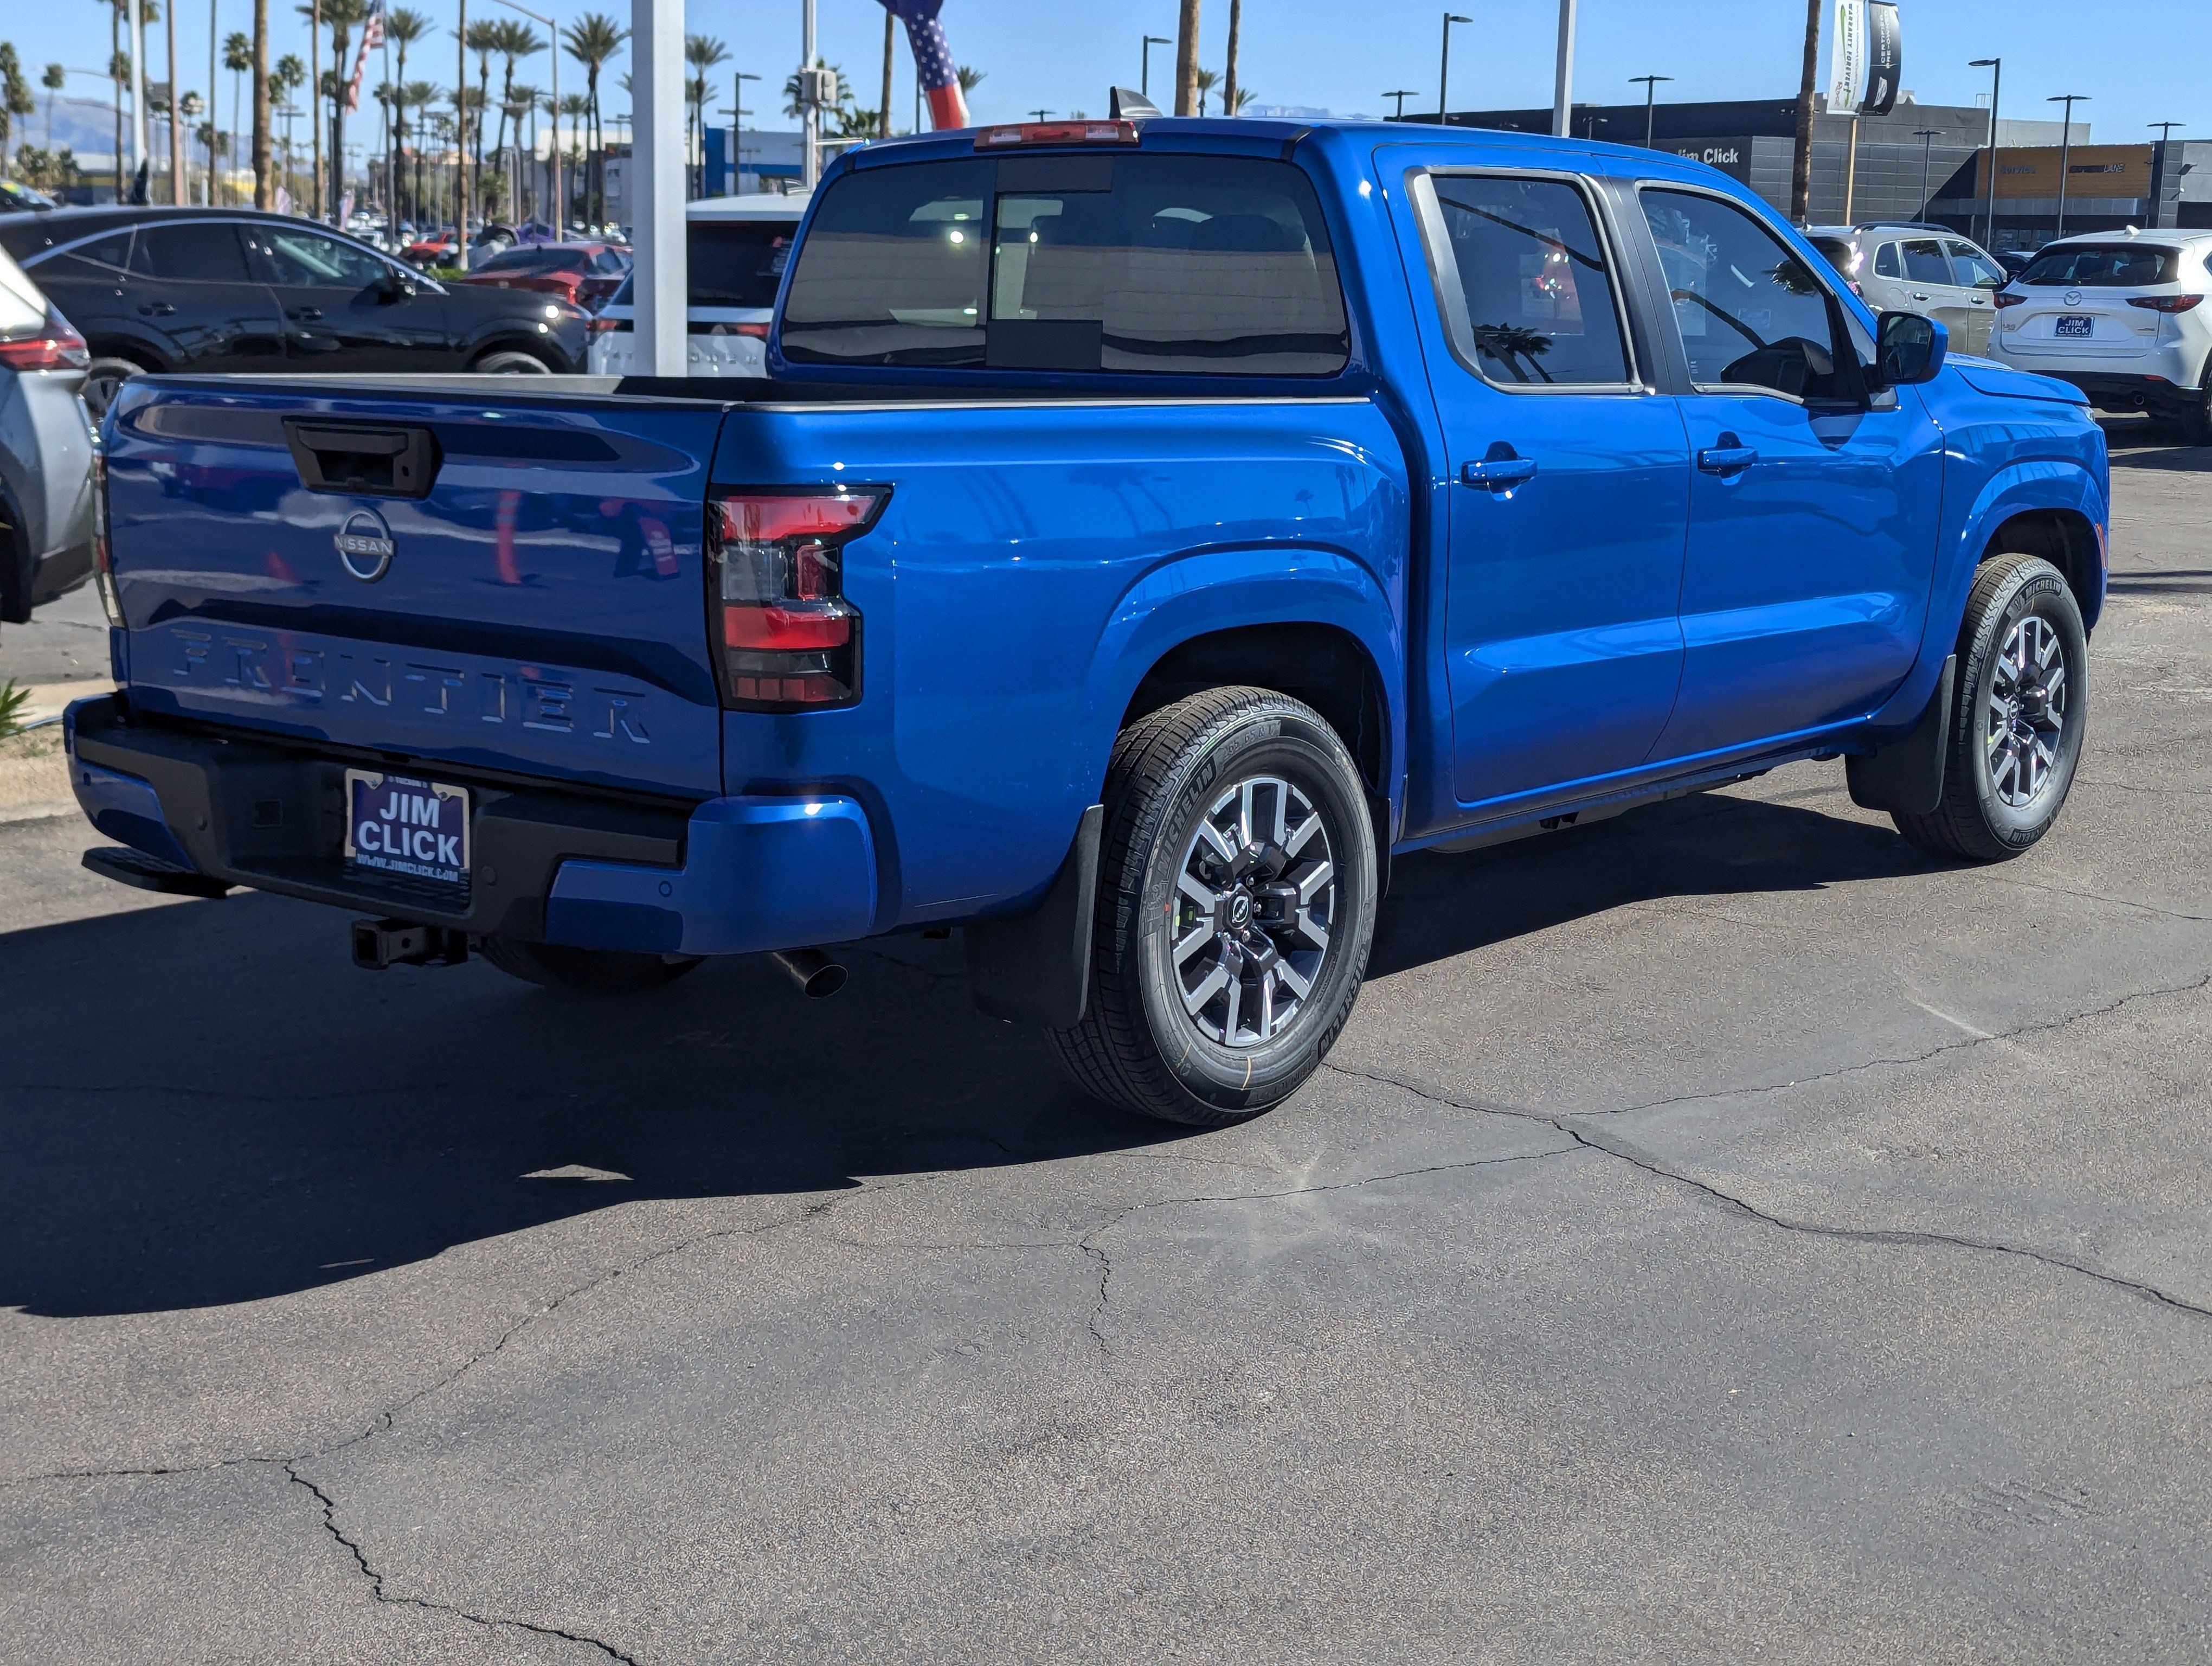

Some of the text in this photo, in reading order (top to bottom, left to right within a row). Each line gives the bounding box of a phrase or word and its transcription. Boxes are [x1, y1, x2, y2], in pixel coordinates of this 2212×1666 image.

[1703, 148, 1739, 164] Click
[334, 535, 393, 556] NISSAN
[171, 628, 651, 744] FRONTIER
[380, 791, 440, 828] JIM
[1158, 762, 1213, 877] MICHELIN
[358, 821, 460, 866] CLICK
